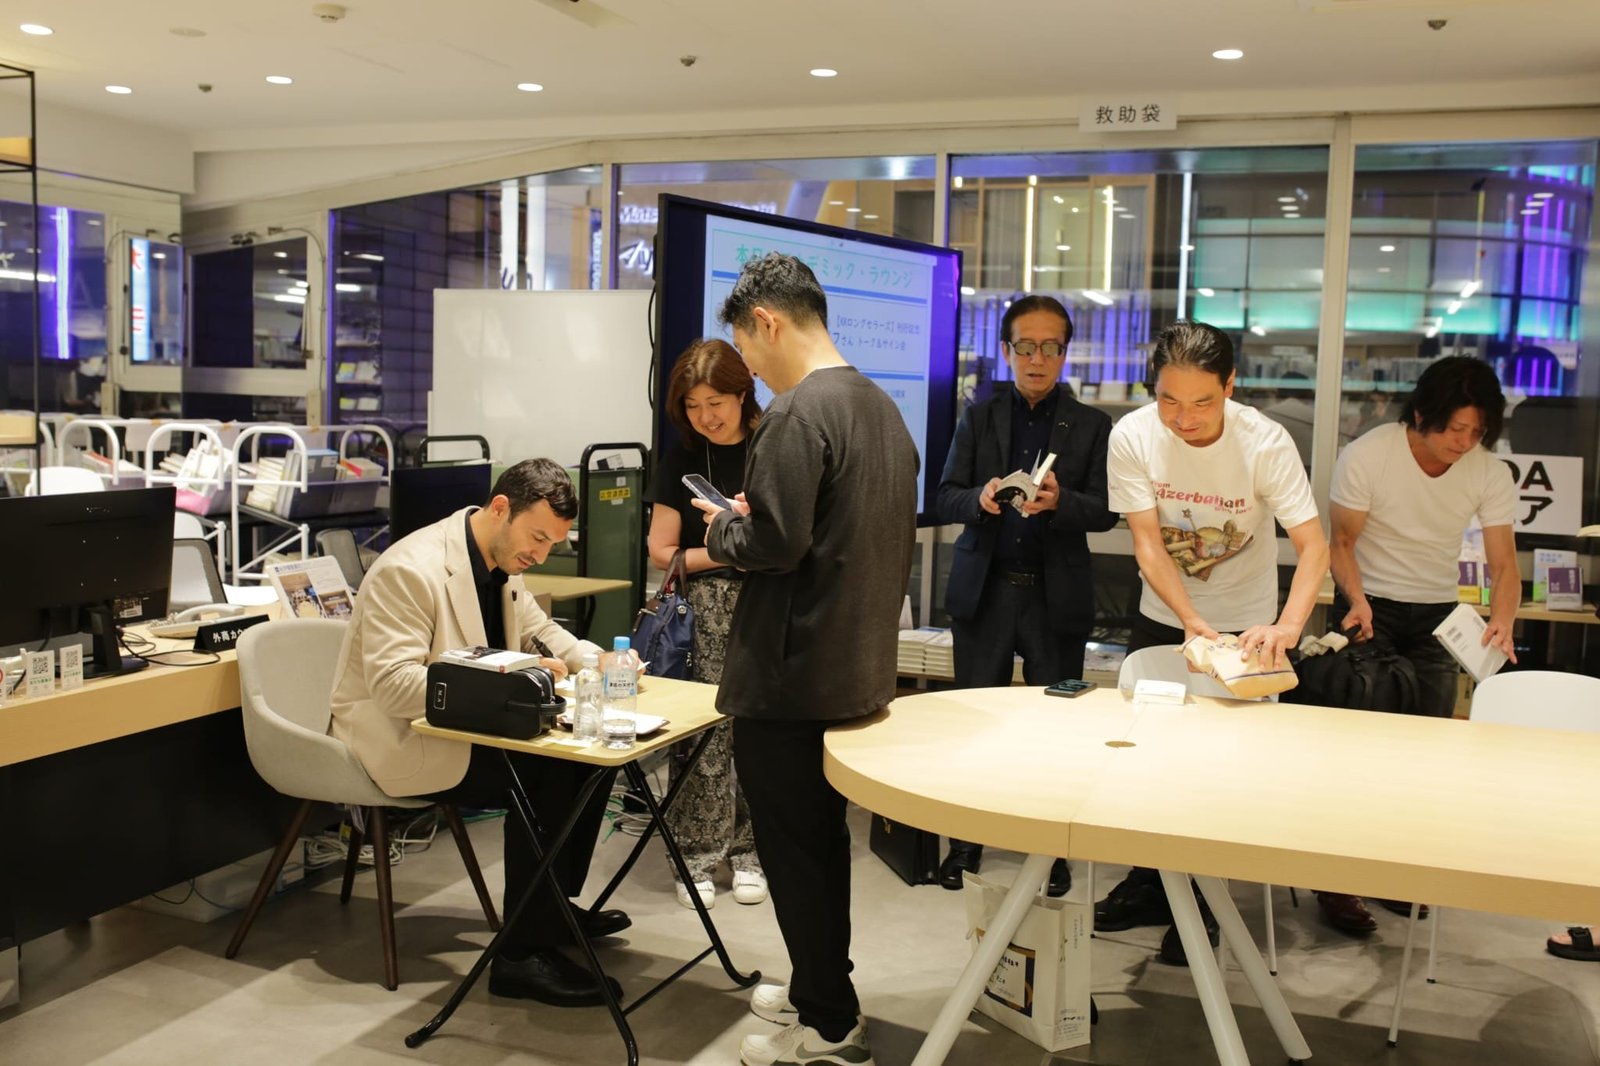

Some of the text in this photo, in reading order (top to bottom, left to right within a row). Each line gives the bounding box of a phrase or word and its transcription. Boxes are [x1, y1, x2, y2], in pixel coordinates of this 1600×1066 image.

[1095, 103, 1161, 125] 救助袋
[1156, 487, 1246, 508] Azerbaijan
